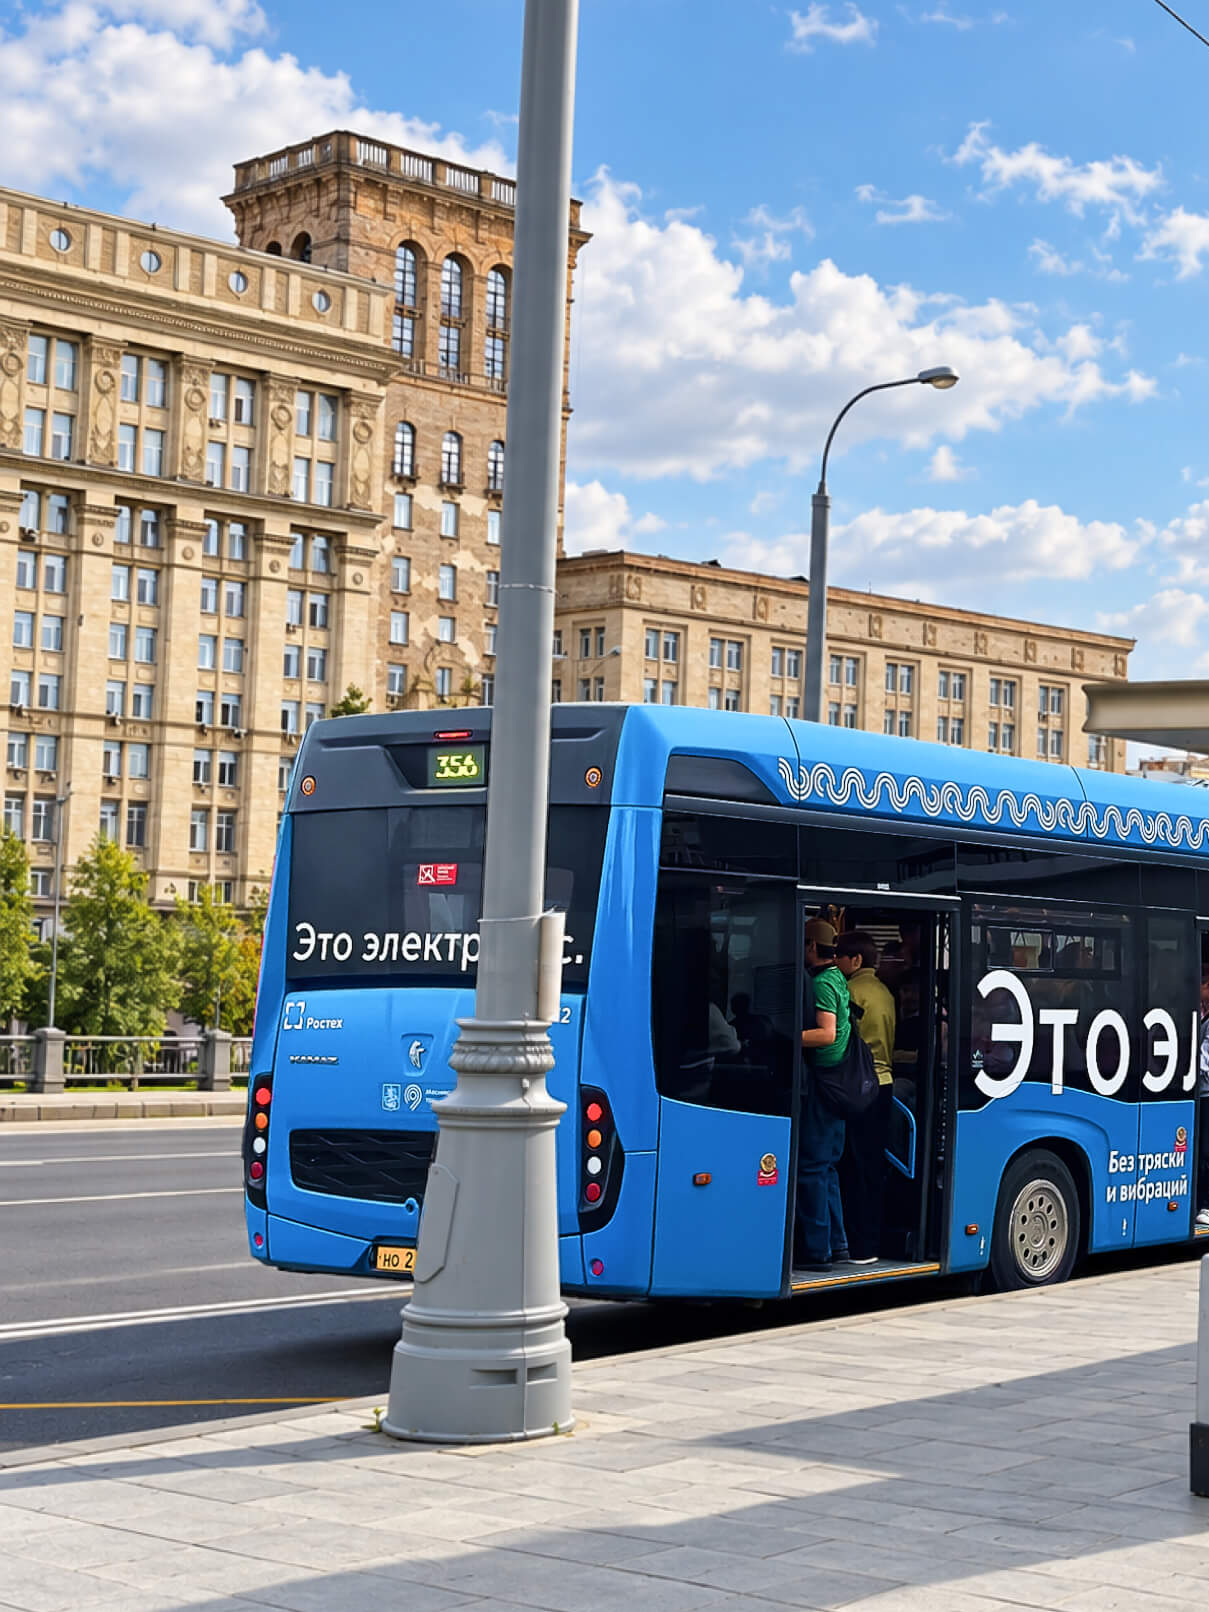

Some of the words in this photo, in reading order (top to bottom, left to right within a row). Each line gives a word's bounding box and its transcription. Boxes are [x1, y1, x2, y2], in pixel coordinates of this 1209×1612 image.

[436, 754, 478, 778] 356
[293, 922, 353, 961] Это
[306, 1017, 343, 1029] Ростех
[974, 969, 1130, 1099] Это
[1108, 1150, 1135, 1173] Без
[1138, 1151, 1185, 1176] тряски
[1106, 1186, 1117, 1203] и
[1120, 1174, 1188, 1205] вибраций
[383, 1253, 400, 1268] НО
